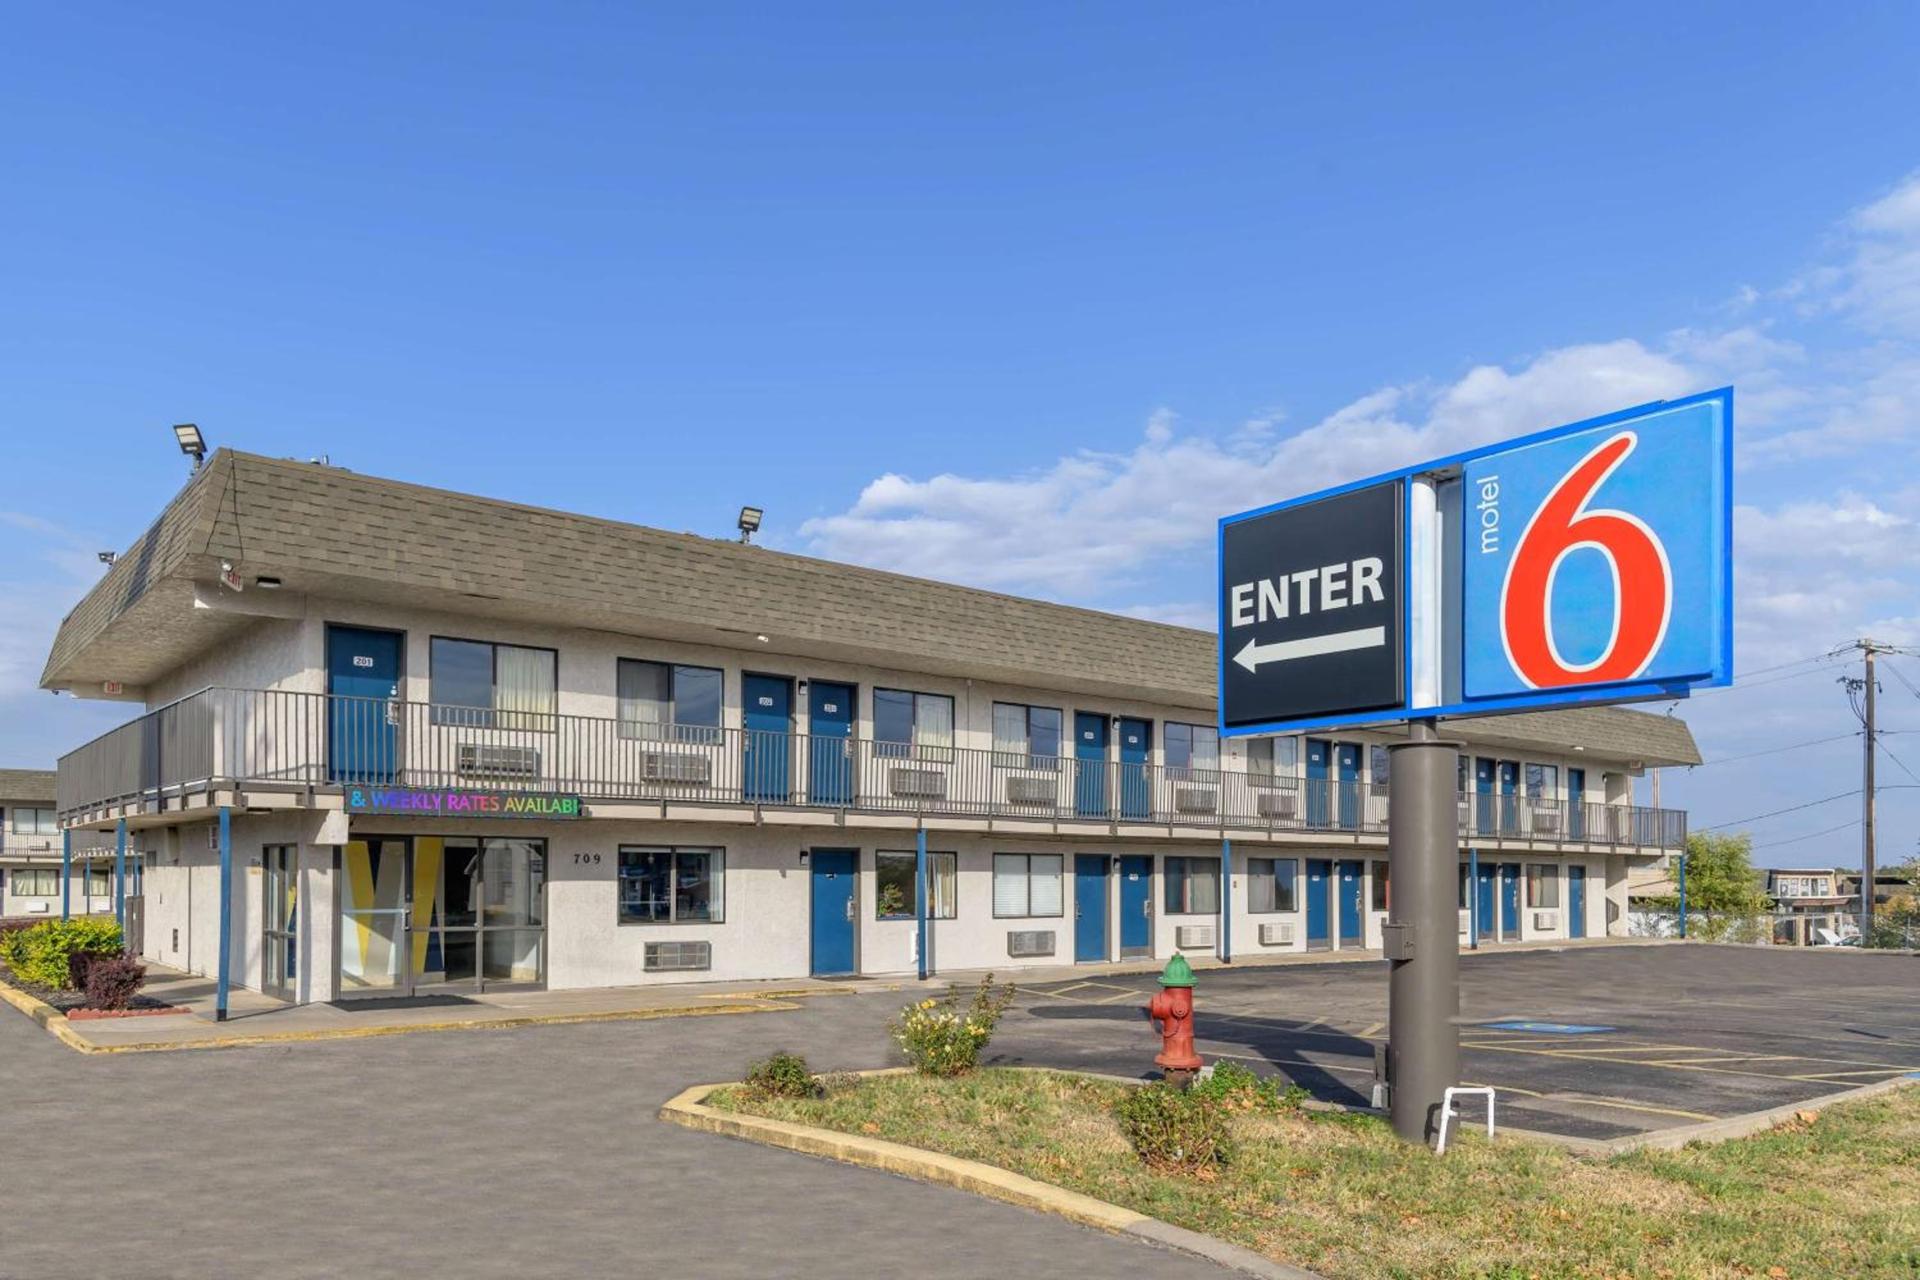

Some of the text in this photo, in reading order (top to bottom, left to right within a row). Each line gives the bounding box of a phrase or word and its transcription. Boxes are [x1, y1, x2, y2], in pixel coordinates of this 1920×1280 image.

[1476, 430, 1674, 690] motel 6
[1231, 557, 1385, 628] ENTER
[351, 790, 367, 808] &
[371, 791, 442, 810] WEEKLY
[447, 794, 499, 812] RATES
[574, 853, 600, 864] 709
